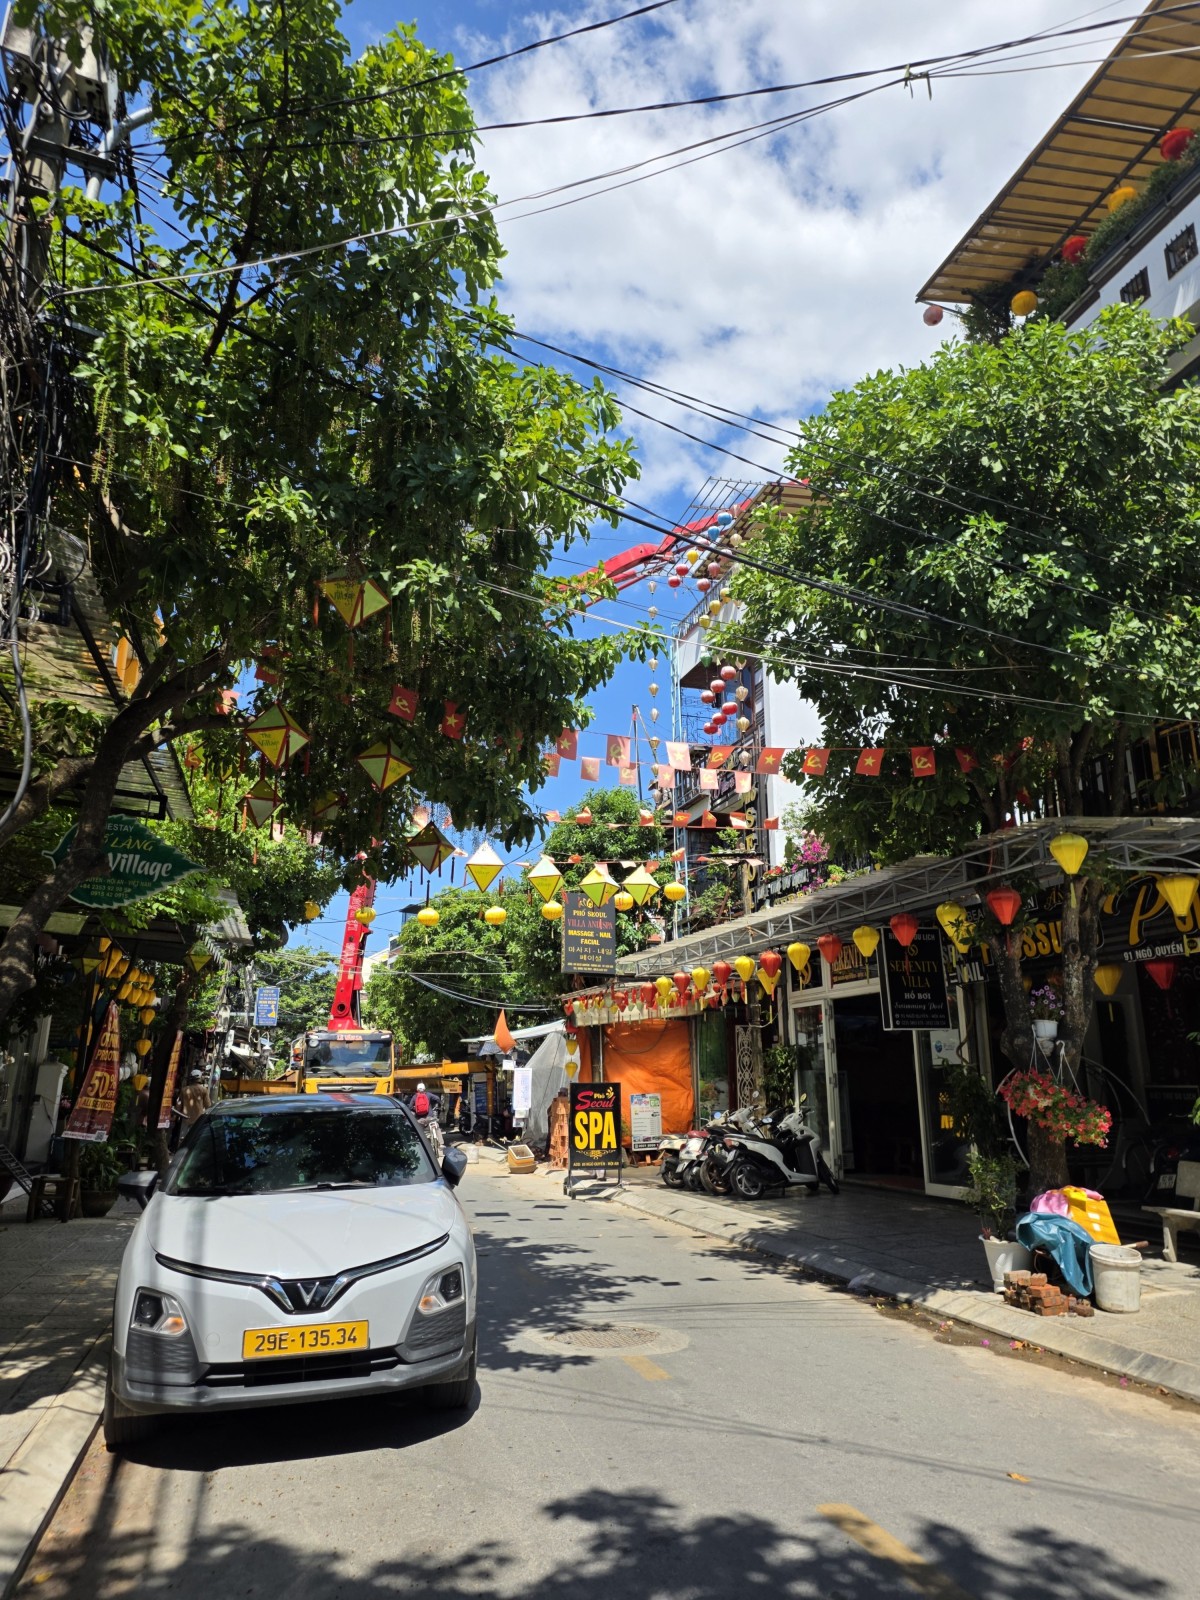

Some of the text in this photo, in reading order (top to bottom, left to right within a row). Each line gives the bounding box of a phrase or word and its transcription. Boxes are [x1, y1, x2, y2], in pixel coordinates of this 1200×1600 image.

[107, 851, 173, 882] Village
[587, 910, 608, 918] SEOUL
[567, 918, 586, 928] VILLA
[568, 929, 613, 939] MASSAGE NAIL
[580, 938, 601, 946] FACIAL
[1123, 951, 1134, 961] 91
[889, 960, 938, 973] SERENITY
[901, 975, 931, 988] VILLA
[575, 1090, 616, 1110] Seoul
[574, 1111, 617, 1150] SPA
[254, 1326, 358, 1352] 29E-135.34
